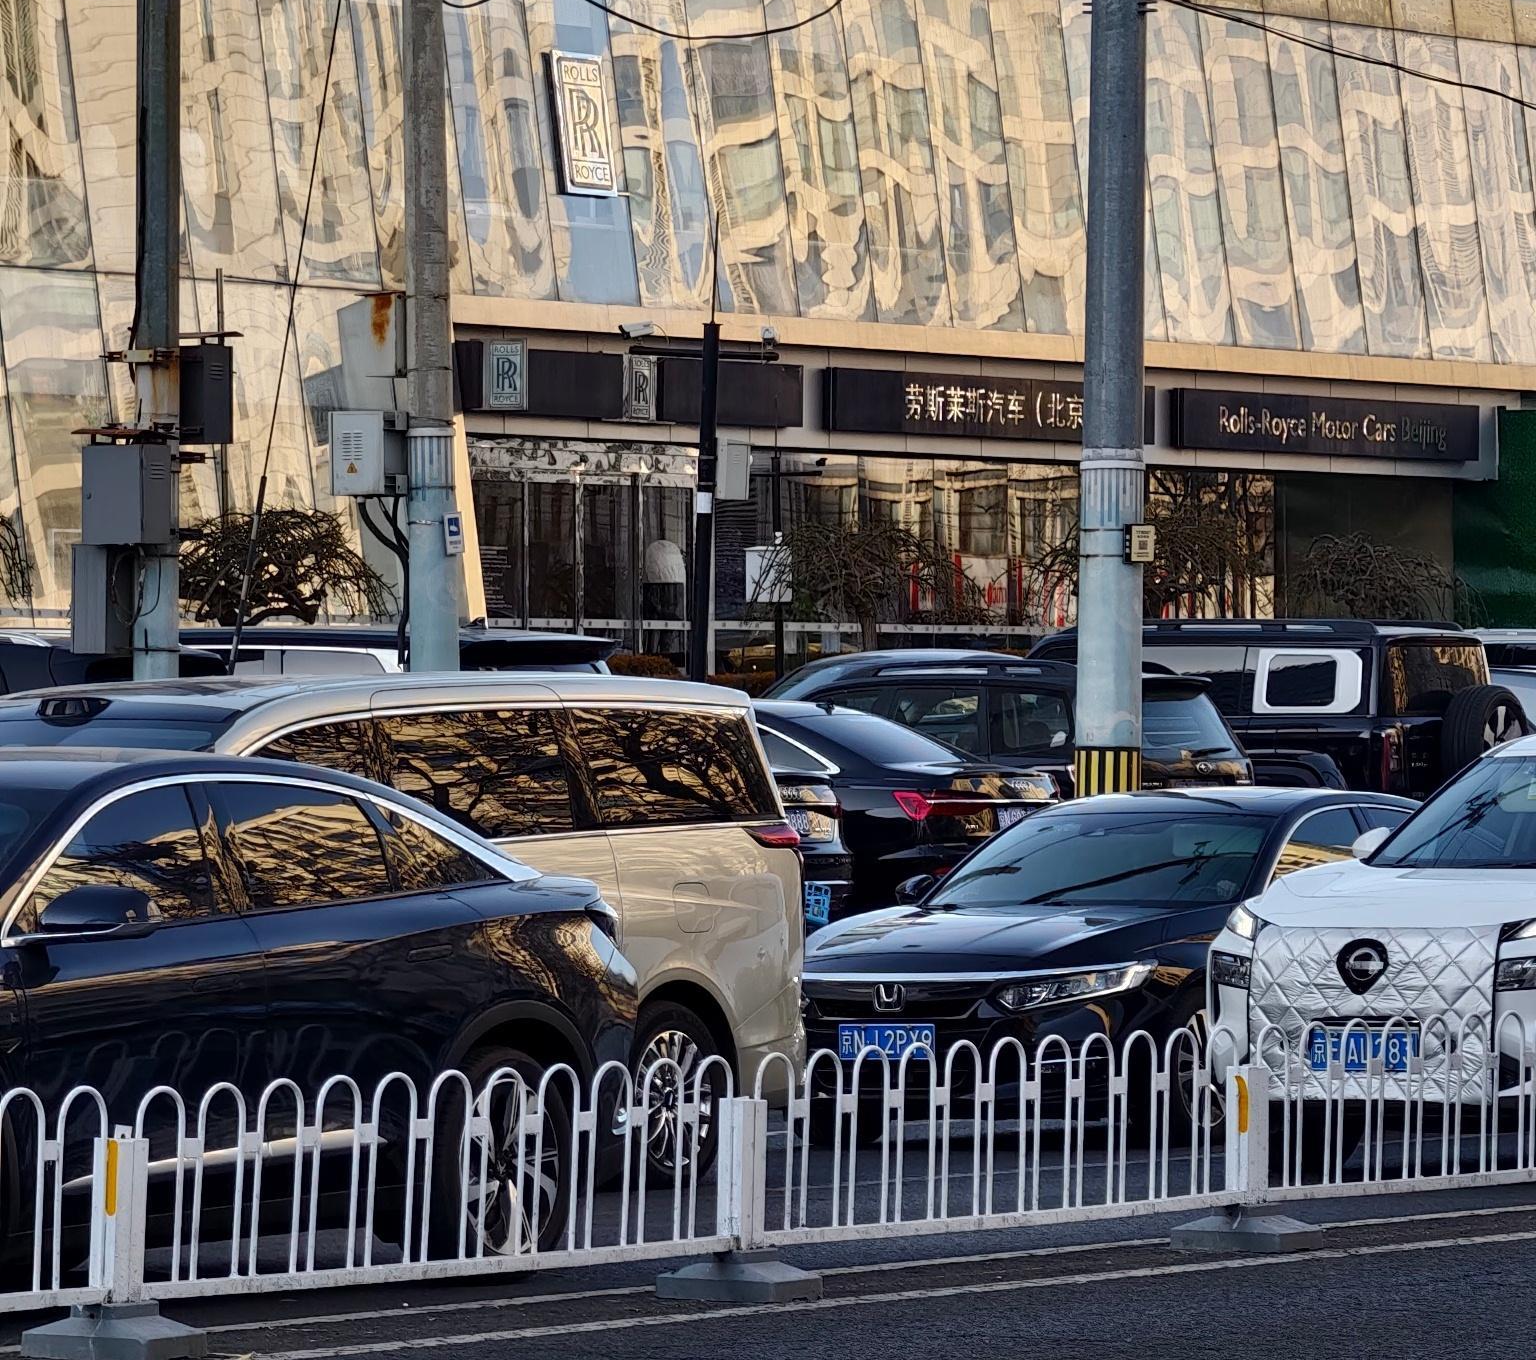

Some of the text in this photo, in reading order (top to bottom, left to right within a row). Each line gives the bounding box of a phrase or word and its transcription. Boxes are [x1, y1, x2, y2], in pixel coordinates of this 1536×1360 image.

[564, 65, 598, 81] ROLLS
[574, 164, 609, 181] ROYCE
[494, 345, 519, 354] ROLLS
[493, 395, 519, 403] ROYCE
[1219, 405, 1448, 451] Rolls-Royce Motor Cars Beijing
